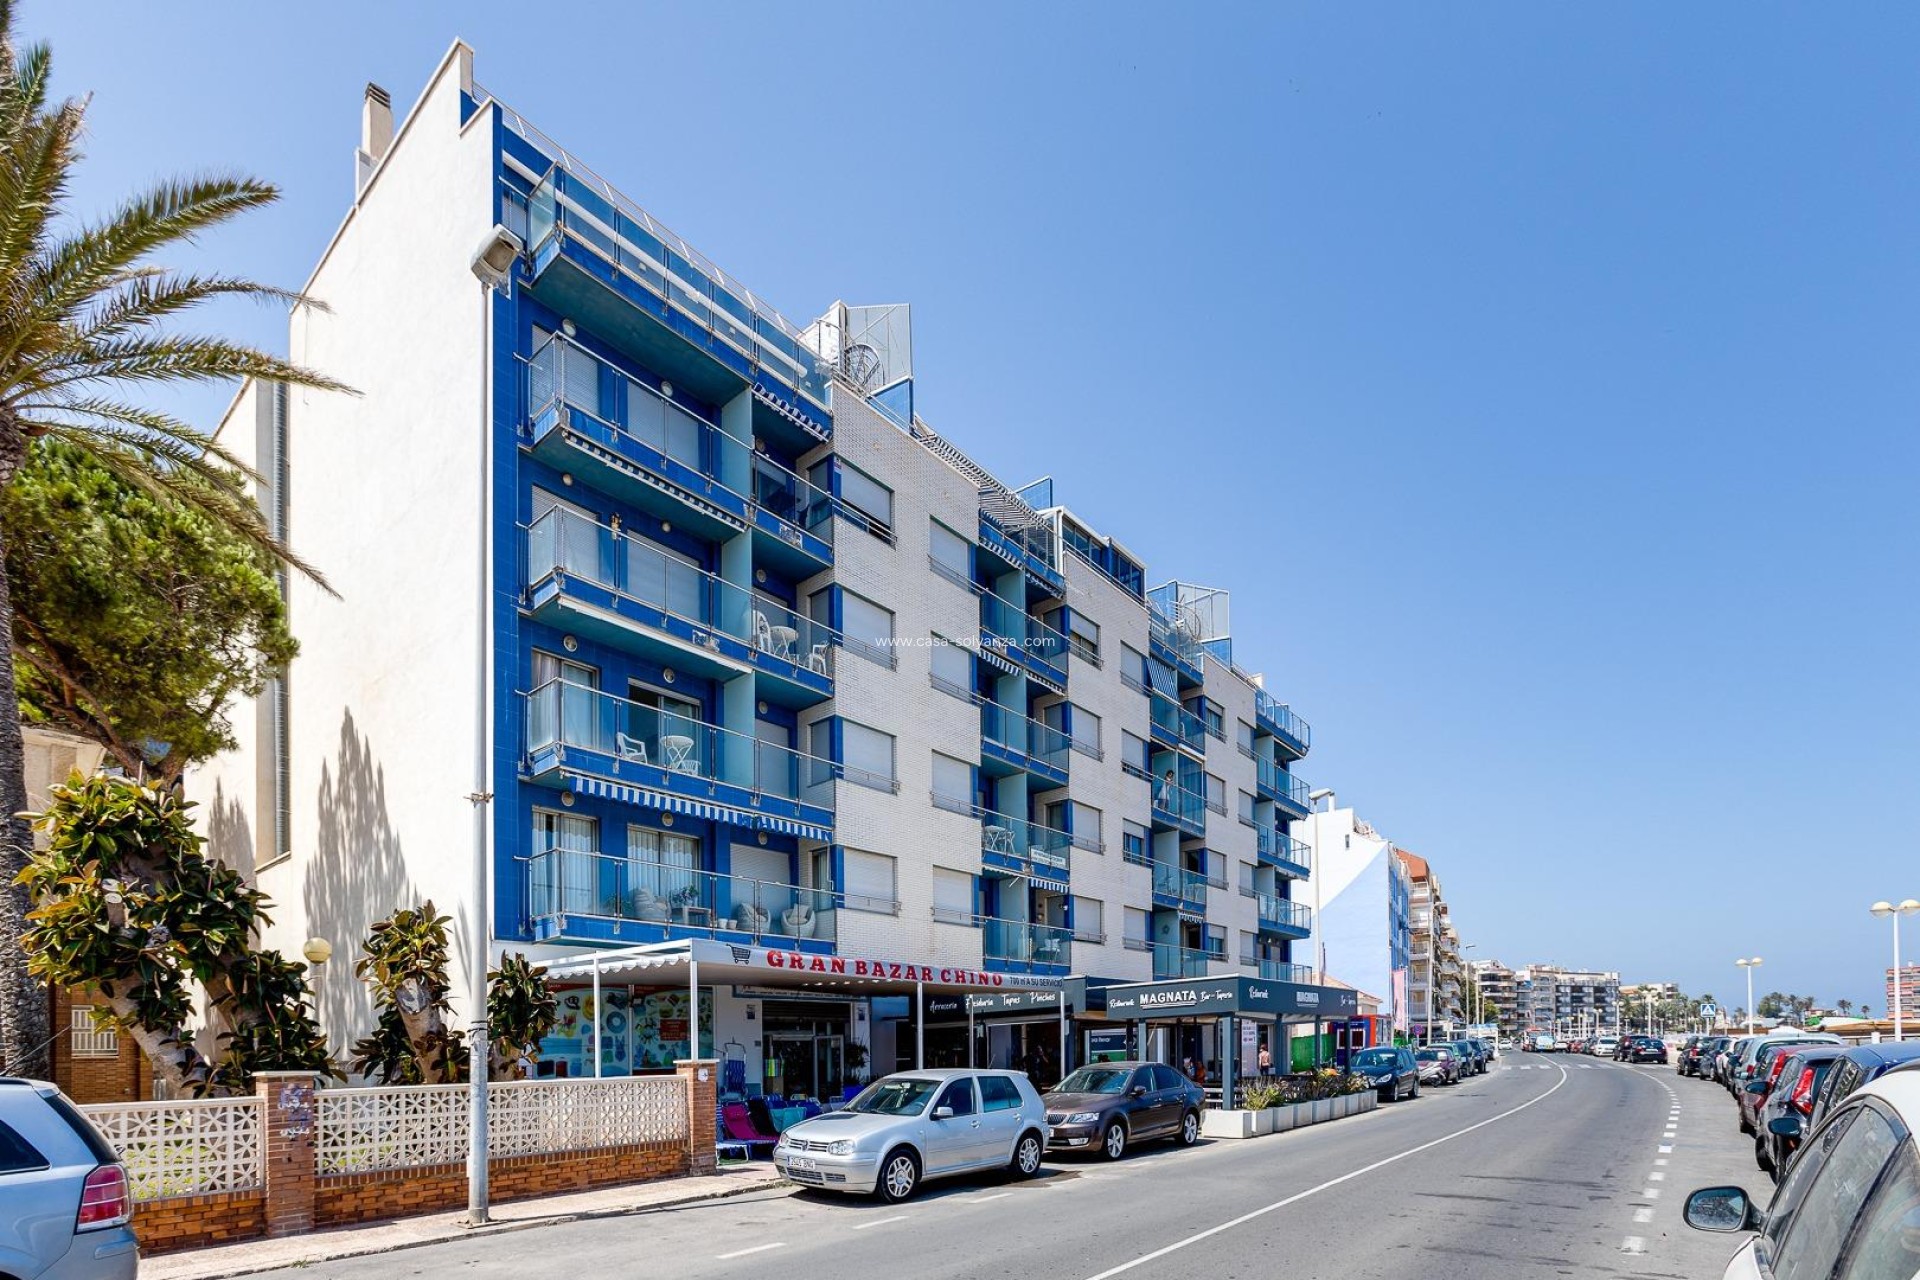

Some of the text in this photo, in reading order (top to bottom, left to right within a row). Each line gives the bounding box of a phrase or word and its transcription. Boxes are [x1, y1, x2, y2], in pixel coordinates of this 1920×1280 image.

[766, 950, 1004, 987] GRAN BAZAR CHINO
[1030, 978, 1039, 987] SU
[1039, 978, 1063, 988] SERVICIO
[1001, 993, 1021, 1007] Tapas
[1139, 990, 1198, 1006] MAGNATA
